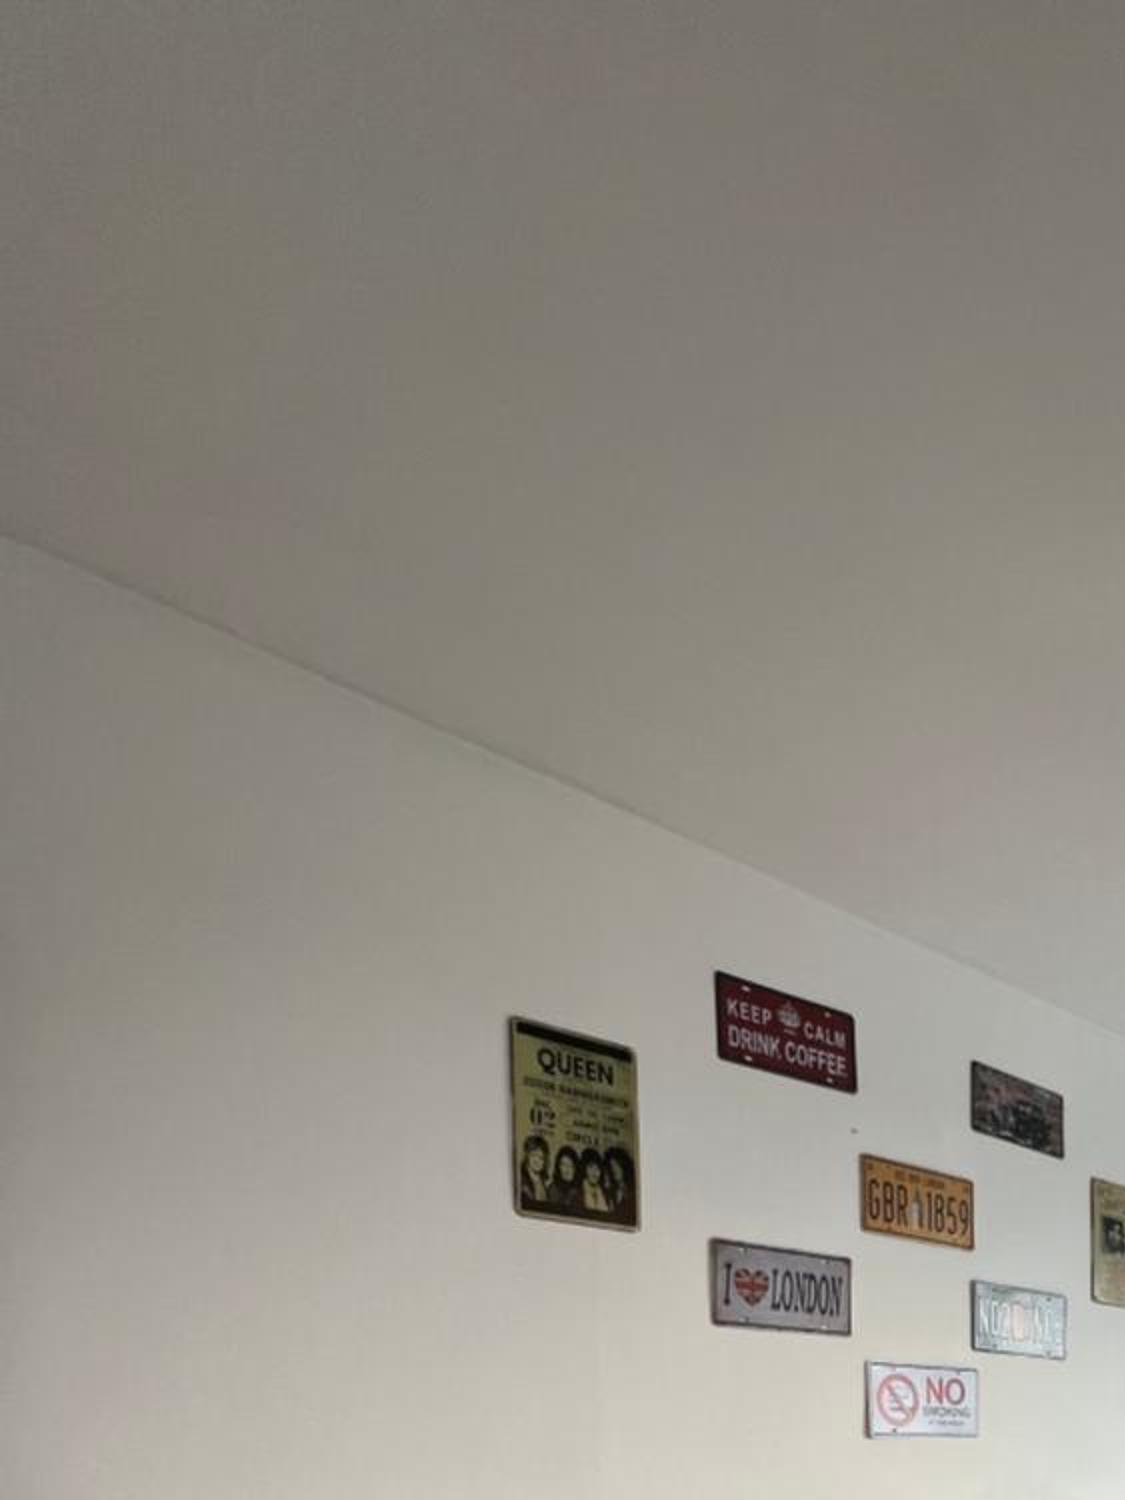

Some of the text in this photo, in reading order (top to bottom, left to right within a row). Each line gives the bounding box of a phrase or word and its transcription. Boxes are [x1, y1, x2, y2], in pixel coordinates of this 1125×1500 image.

[726, 998, 846, 1050] KEEP CALM
[537, 1047, 614, 1086] QUEEN
[728, 1024, 847, 1077] DRINK COFFEE
[869, 1178, 908, 1228] GBR
[723, 1262, 843, 1317] I LONDON
[926, 1375, 966, 1405] NO
